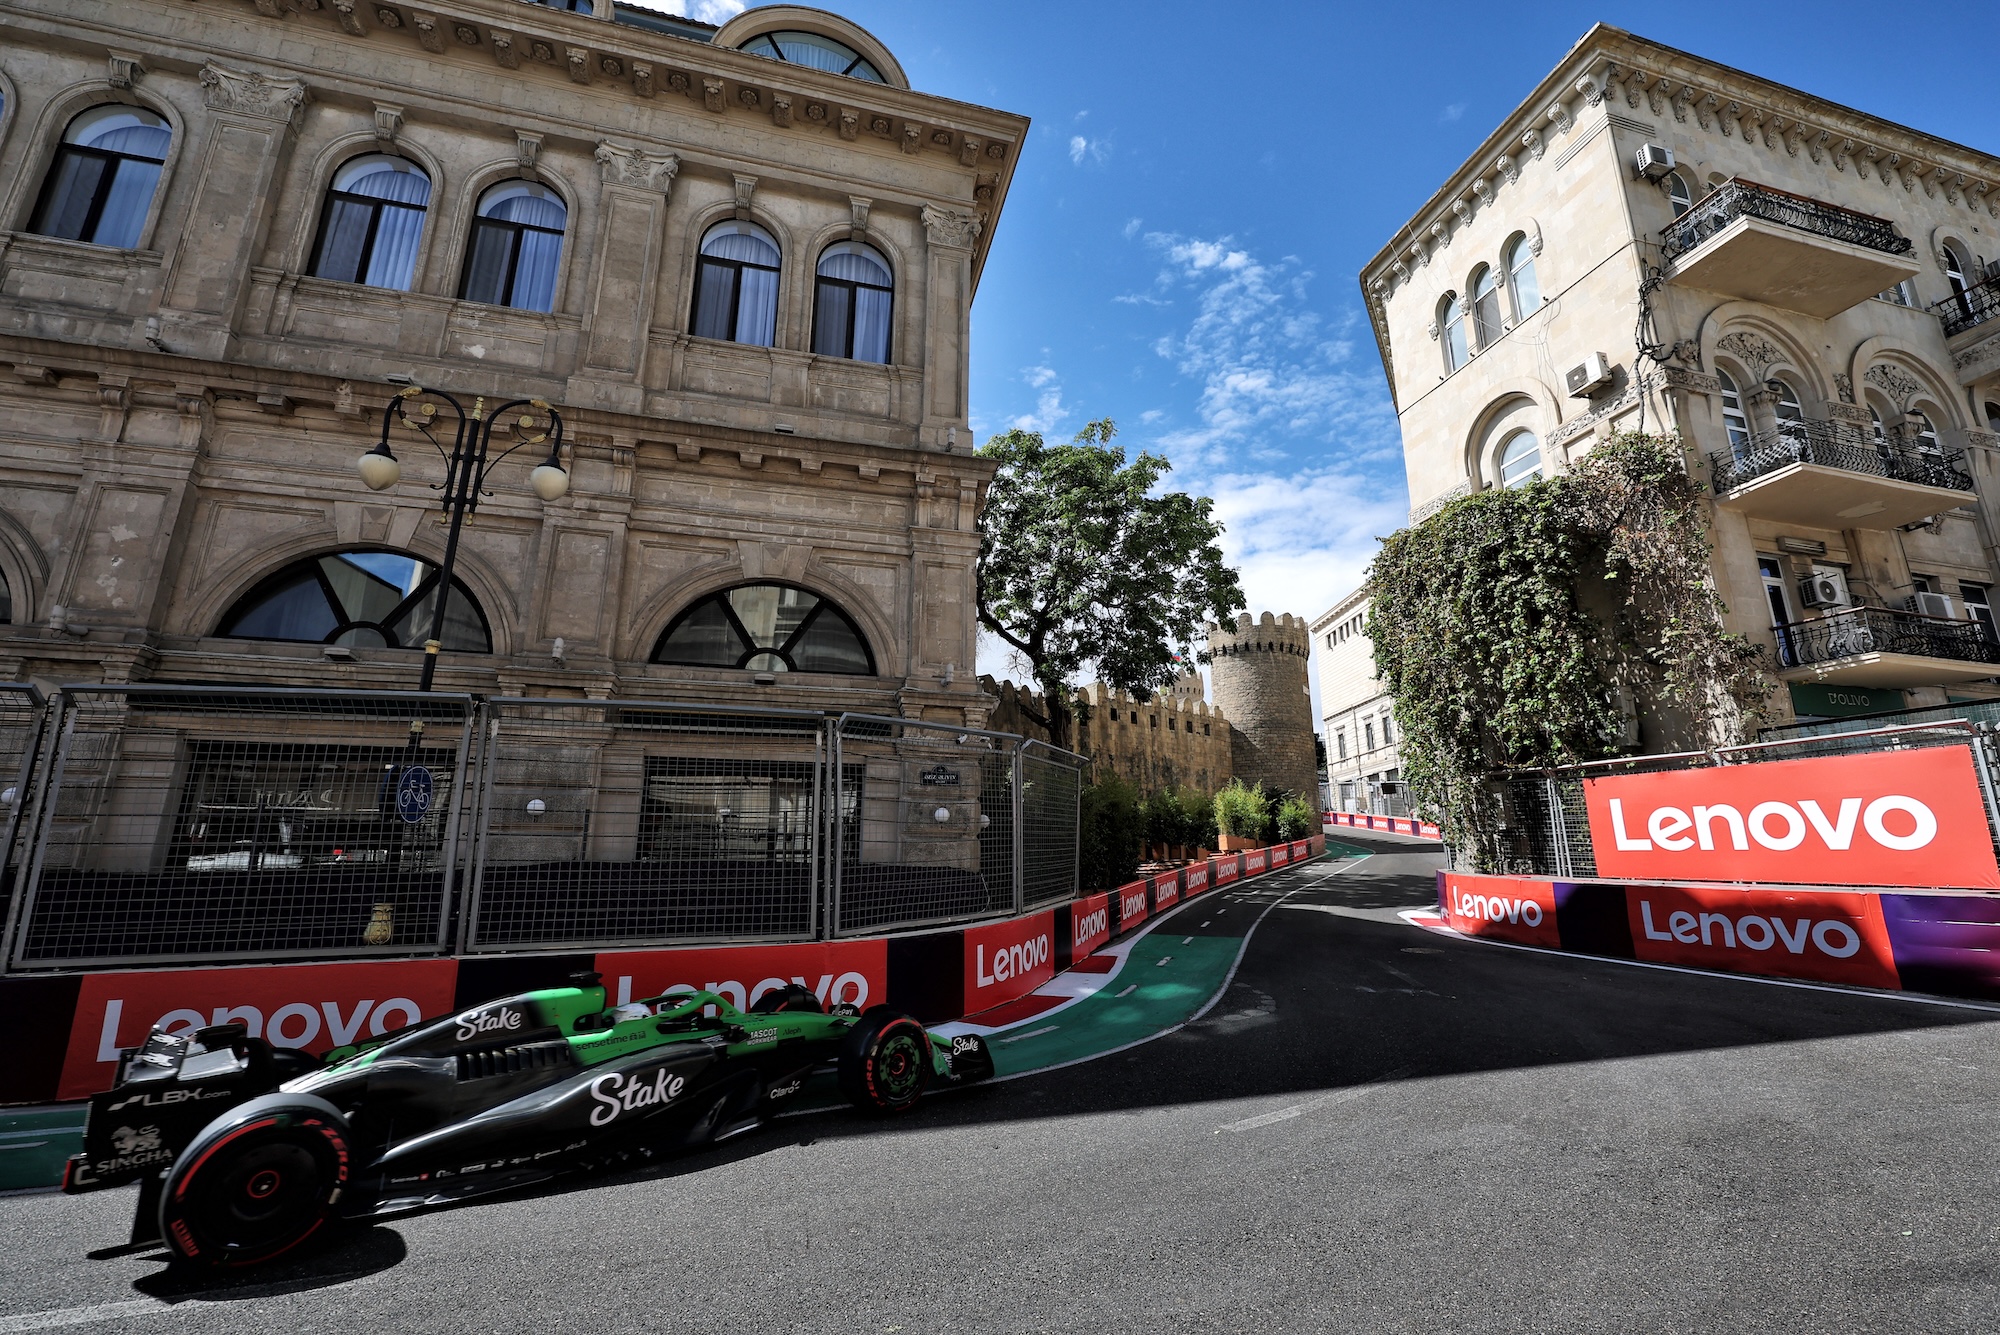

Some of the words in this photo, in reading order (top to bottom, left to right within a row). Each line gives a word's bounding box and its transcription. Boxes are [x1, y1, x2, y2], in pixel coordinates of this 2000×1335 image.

[1354, 817, 1367, 825] Lenovo
[1373, 818, 1387, 828] Lenovo
[1394, 820, 1411, 831] Lenovo
[1420, 824, 1438, 835] Lenovo
[1609, 795, 1937, 852] Lenovo
[1272, 849, 1287, 863] Lenovo
[1293, 845, 1307, 857] Lenovo
[1217, 862, 1237, 878] Lenovo
[1246, 856, 1265, 870] Lenovo
[1187, 869, 1207, 889] Lenovo
[1156, 880, 1177, 903] Lenovo
[1121, 892, 1146, 920] Lenovo
[1453, 886, 1543, 927] Lenovo
[1075, 908, 1106, 947] Lenovo
[1640, 900, 1860, 958] Lenovo
[977, 934, 1048, 988] Lenovo
[455, 1006, 521, 1041] Stake
[575, 1035, 629, 1052] sensetime
[953, 1037, 979, 1056] Stake
[589, 1067, 685, 1127] Stake
[770, 1084, 796, 1100] Claro
[97, 1149, 173, 1174] SINGHA
